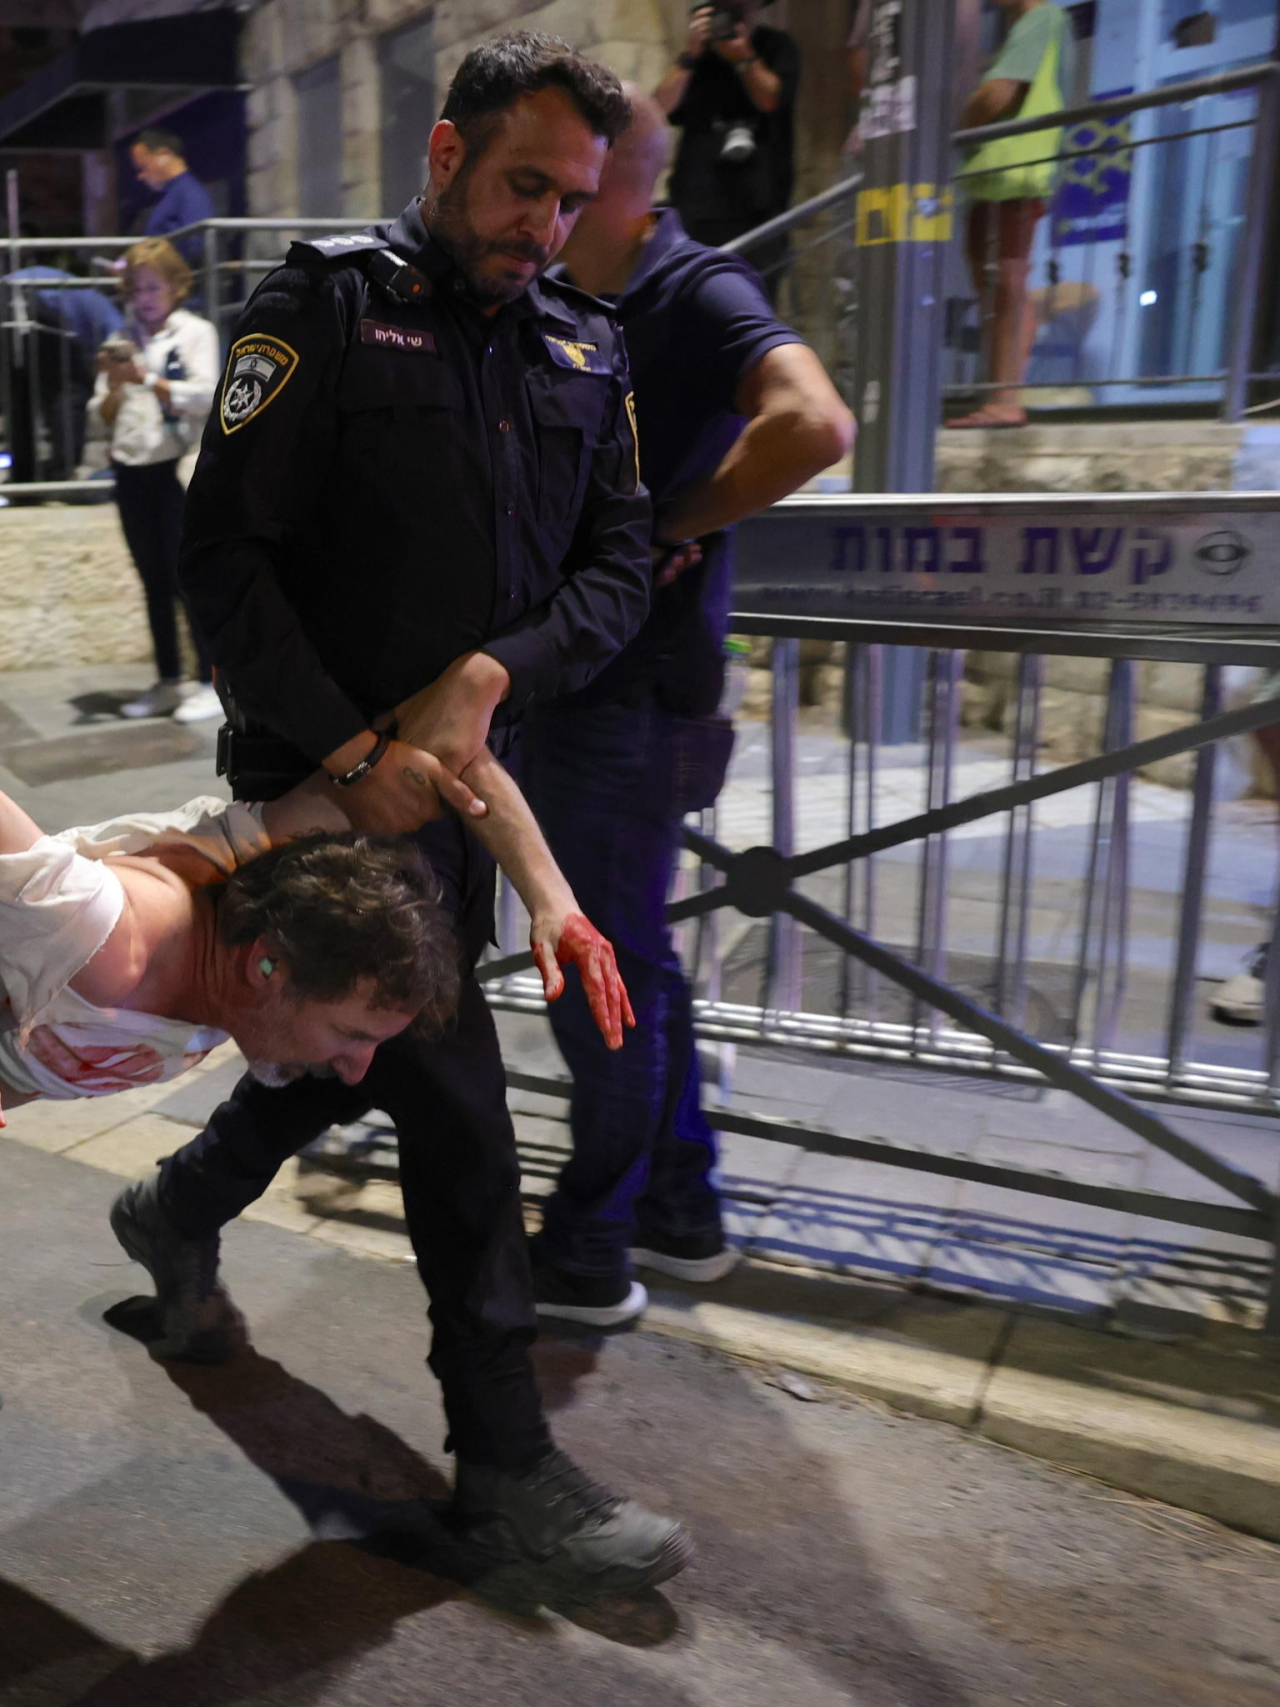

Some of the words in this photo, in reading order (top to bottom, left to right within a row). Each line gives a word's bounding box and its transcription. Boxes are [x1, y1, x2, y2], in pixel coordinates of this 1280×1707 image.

[375, 328, 405, 346] אליהו
[406, 336, 423, 347] שי
[831, 526, 984, 573] במות
[1018, 526, 1175, 585] קשת
